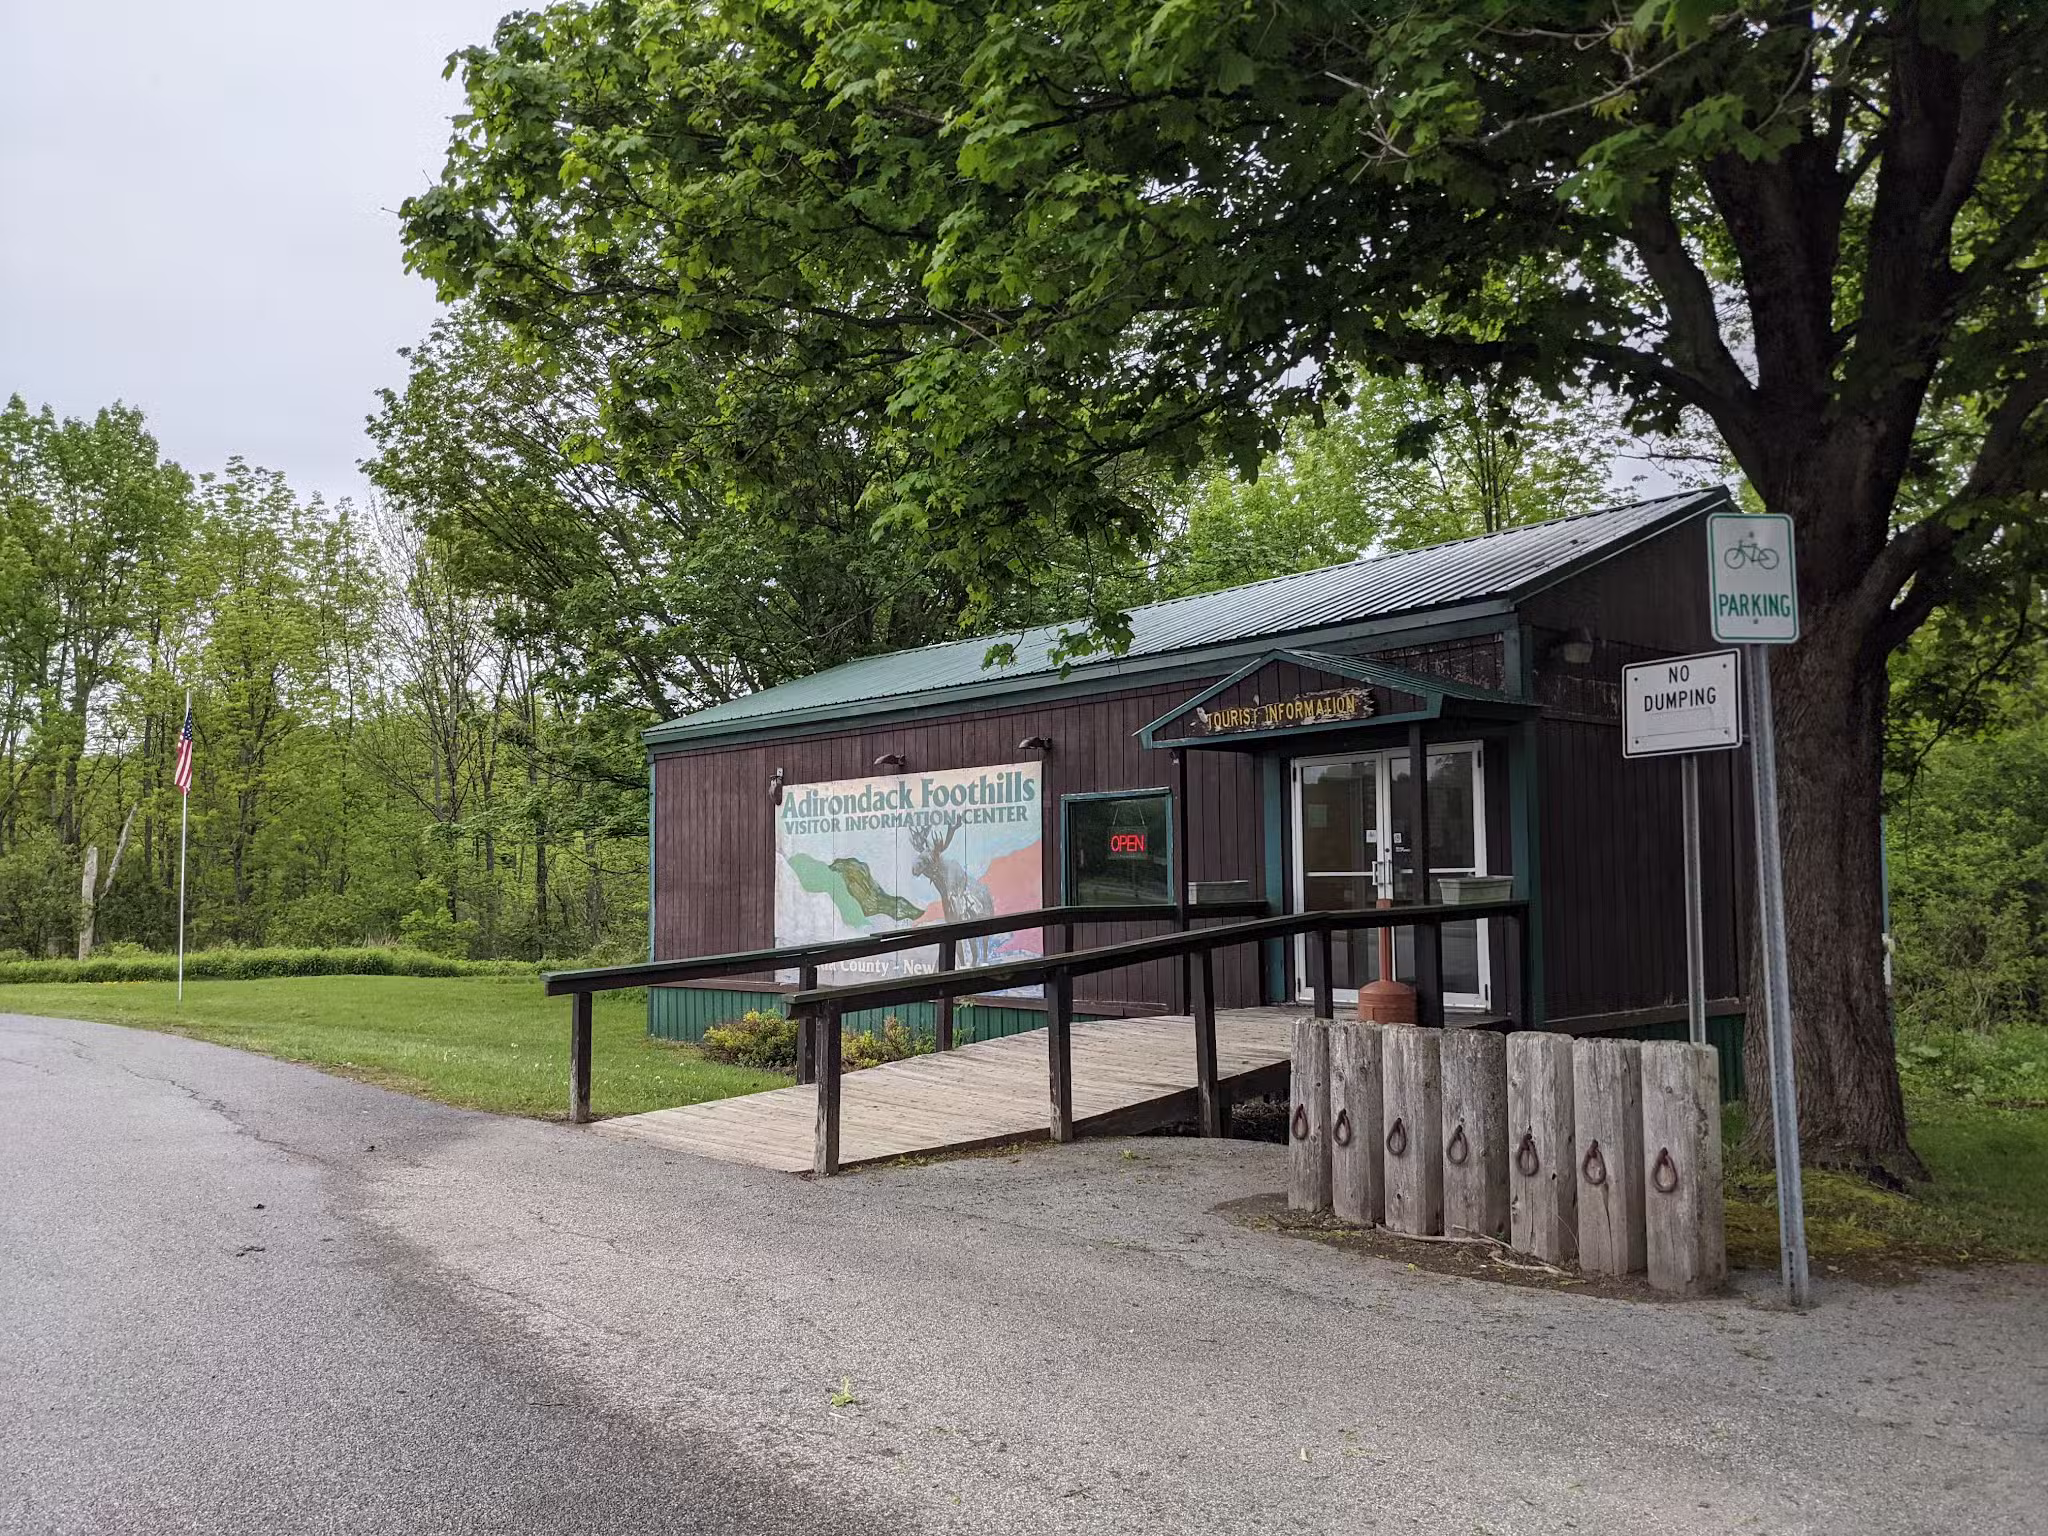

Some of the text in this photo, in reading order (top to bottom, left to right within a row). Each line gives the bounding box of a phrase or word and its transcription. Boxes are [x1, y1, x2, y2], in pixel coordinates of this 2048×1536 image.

[1719, 594, 1791, 617] PARKING
[1668, 665, 1690, 683] NO
[1644, 687, 1716, 712] DUMPING
[1207, 696, 1355, 730] TOURIST INFORMATION
[782, 771, 1036, 819] Adirondack Foothills
[784, 805, 1029, 835] VISITOR INFORMATION CENTER
[1111, 834, 1145, 852] OPEN
[841, 959, 889, 977] County
[904, 959, 937, 975] New
